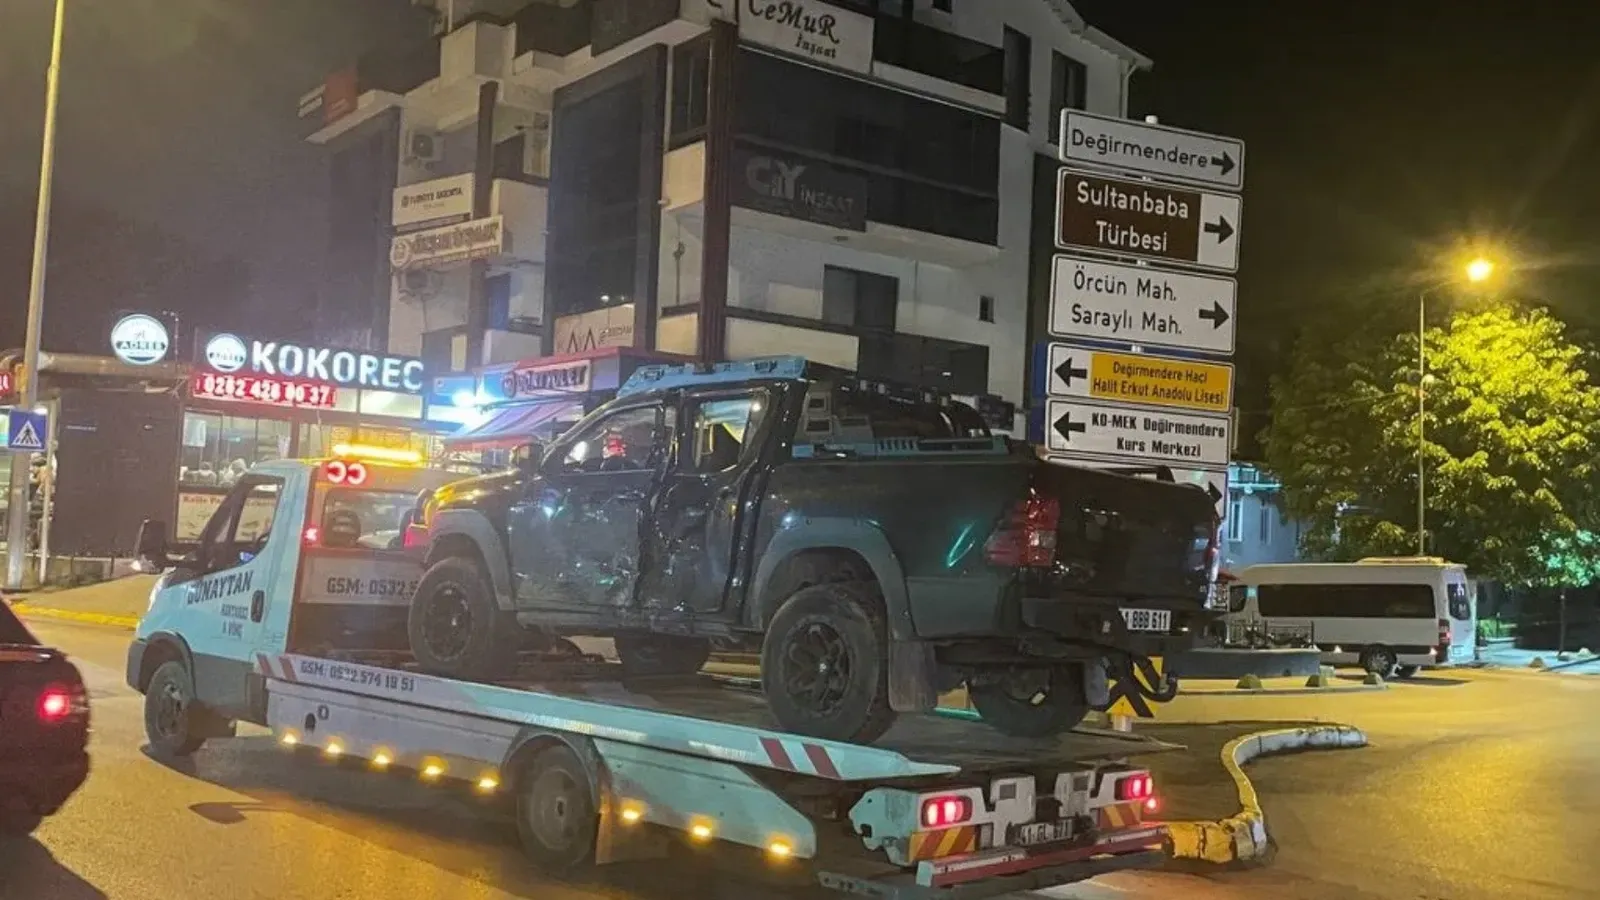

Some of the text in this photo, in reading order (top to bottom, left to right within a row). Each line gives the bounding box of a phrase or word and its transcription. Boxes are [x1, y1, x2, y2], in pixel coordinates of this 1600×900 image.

[1072, 129, 1208, 168] Değirmendere
[1077, 181, 1189, 219] Sultanbaba
[1096, 220, 1168, 251] Türbesi
[1074, 264, 1177, 301] Örcün Mah.
[1071, 303, 1182, 334] Saraylı Mah.
[1113, 361, 1183, 381] Değirmendere
[1093, 378, 1224, 405] Halit Erkut Anadolu Lisesi
[1092, 412, 1225, 438] KO-MEK Değirmendere
[1117, 437, 1201, 458] Kurs Merkezi
